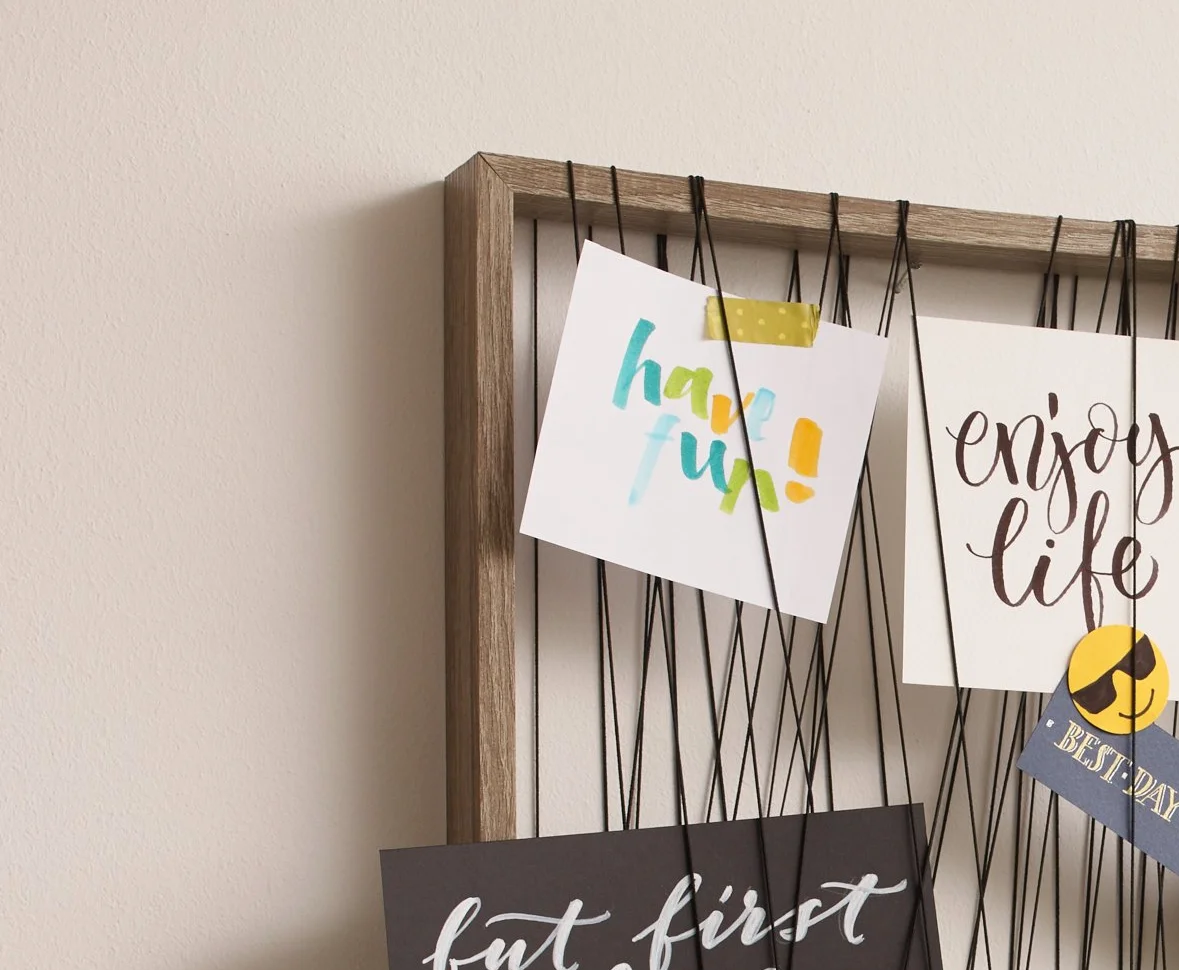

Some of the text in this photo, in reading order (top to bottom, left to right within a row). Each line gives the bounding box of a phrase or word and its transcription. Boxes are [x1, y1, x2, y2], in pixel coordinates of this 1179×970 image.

[612, 318, 776, 441] have
[628, 413, 823, 515] fun!
[966, 490, 1159, 633] life
[1054, 720, 1133, 784] BEST
